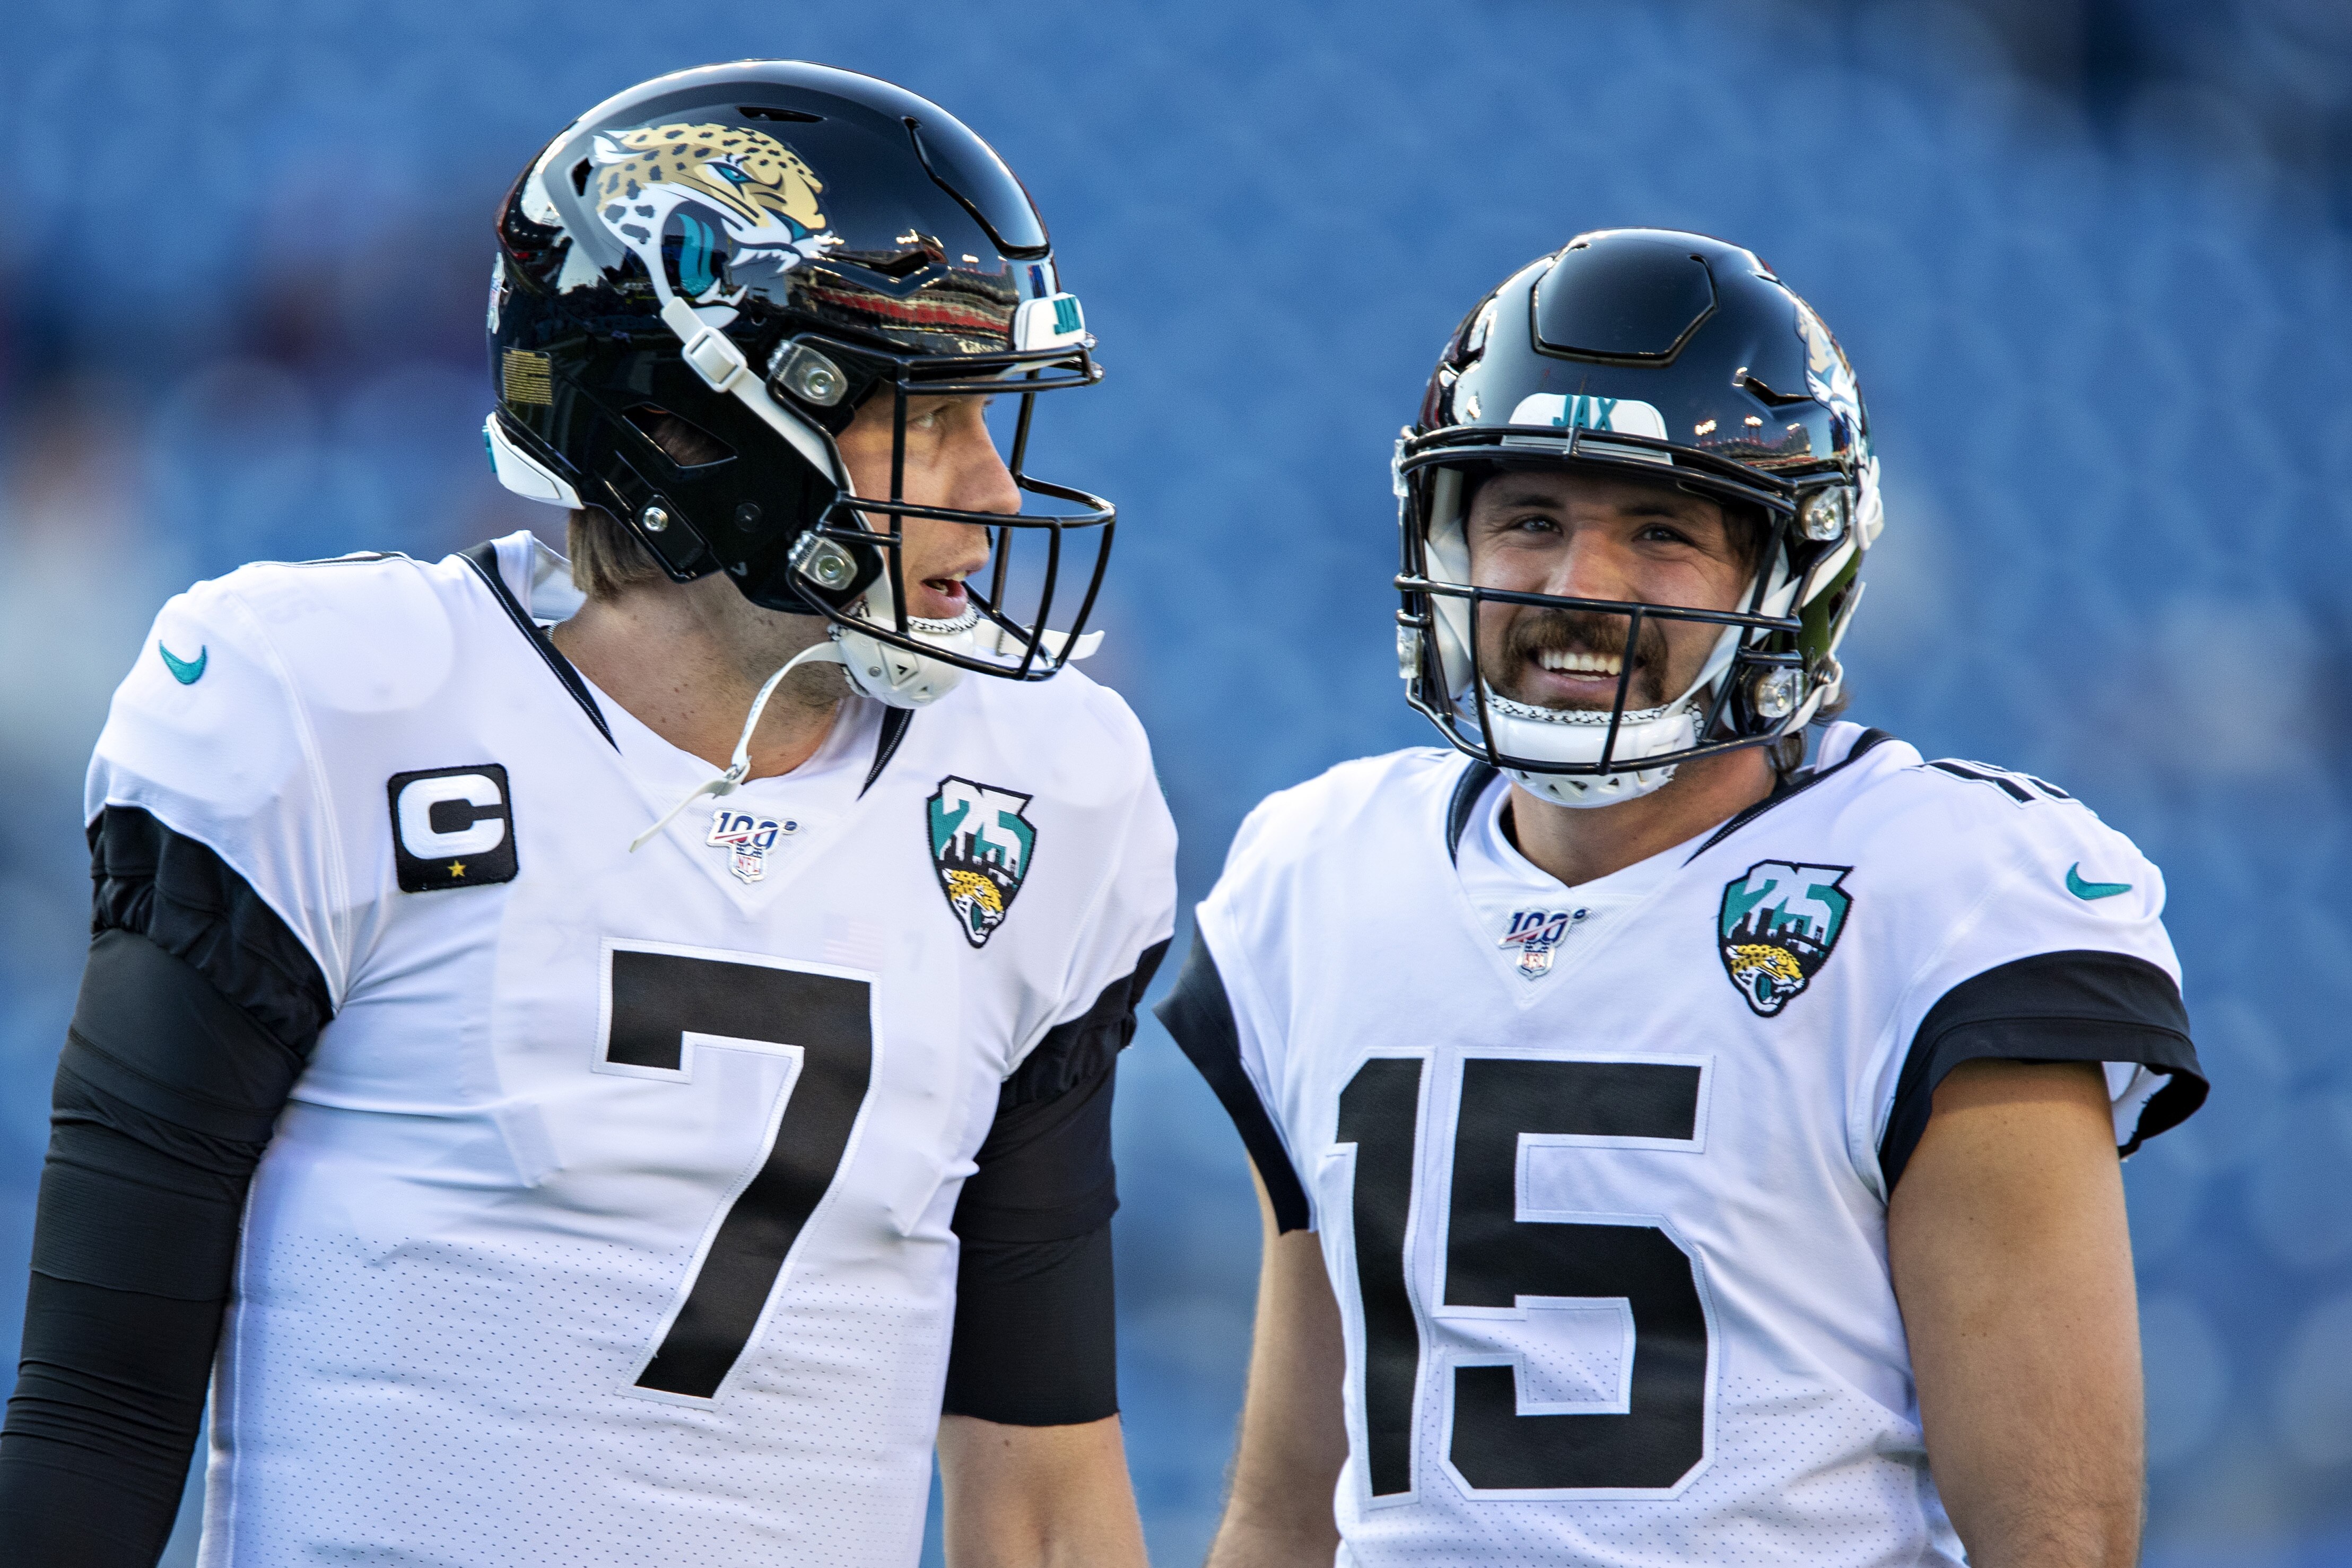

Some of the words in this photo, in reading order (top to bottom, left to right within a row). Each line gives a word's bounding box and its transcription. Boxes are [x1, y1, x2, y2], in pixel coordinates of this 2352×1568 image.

[1552, 394, 1617, 431] JAX
[398, 774, 505, 859] C
[939, 779, 1028, 879] 25
[736, 856, 761, 873] NFL
[1727, 863, 1845, 946] 25
[606, 949, 873, 1399] 7
[1335, 1057, 1708, 1497] 15
